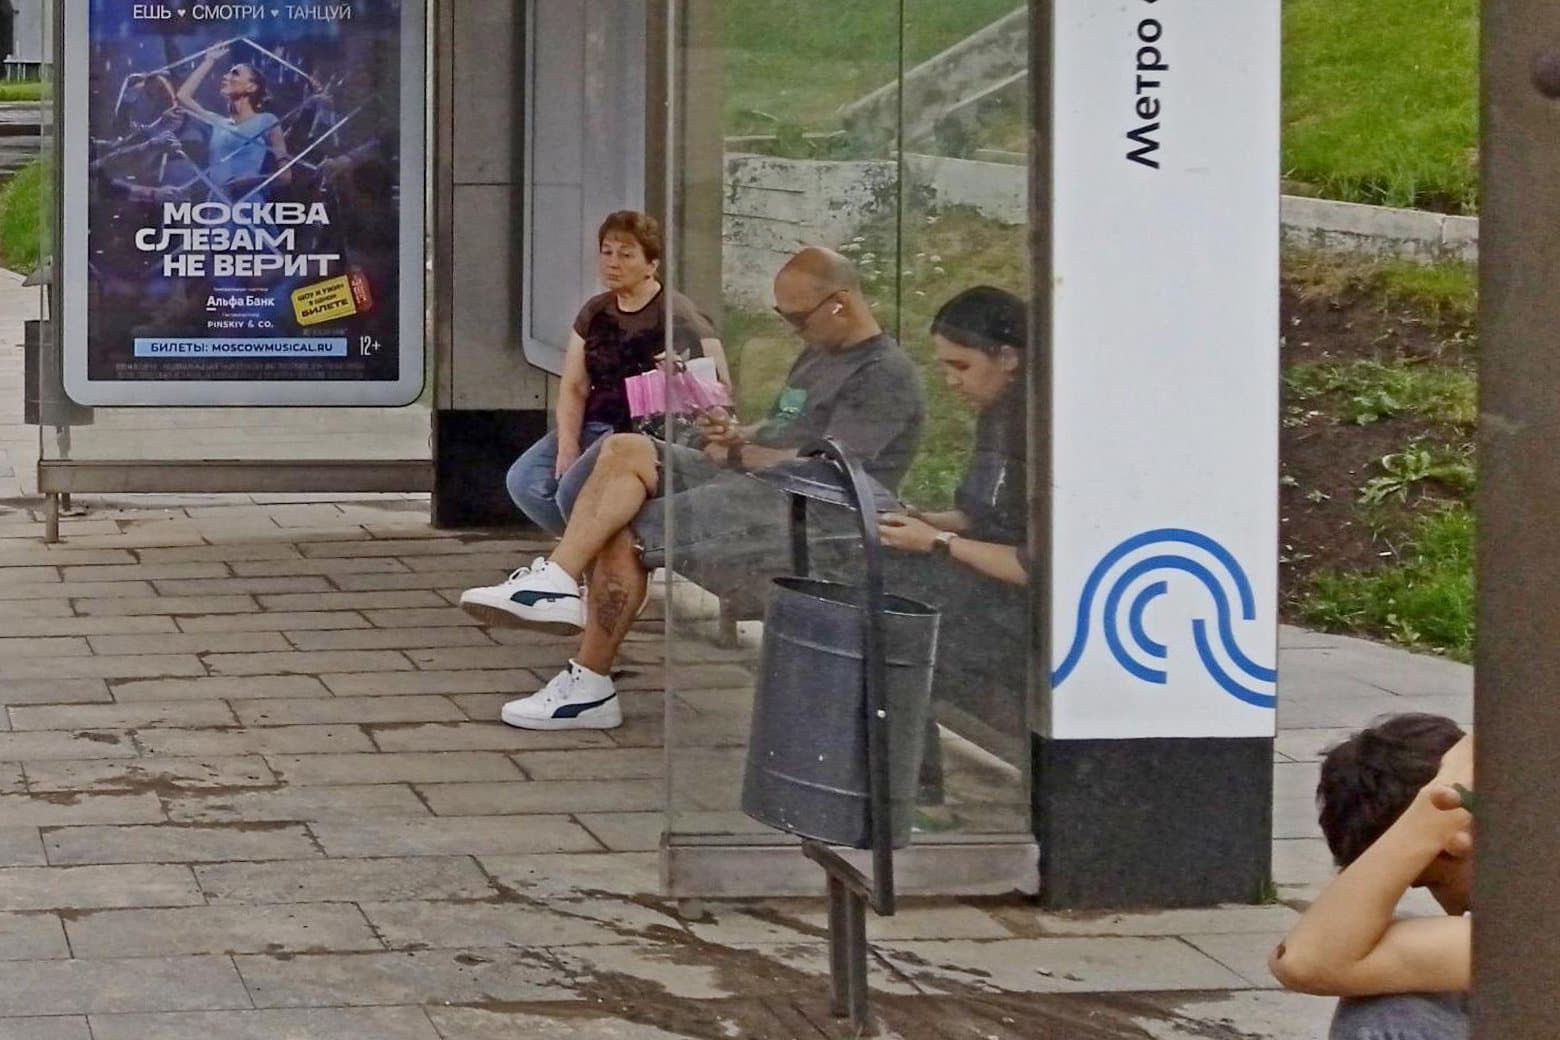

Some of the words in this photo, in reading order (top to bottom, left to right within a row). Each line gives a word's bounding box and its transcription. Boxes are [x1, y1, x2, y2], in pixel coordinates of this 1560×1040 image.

[133, 5, 172, 19] ЕШЬ
[192, 5, 265, 20] СМОТРИ
[286, 3, 352, 22] ТАНЦУЙ
[1126, 18, 1169, 169] Метро
[163, 202, 330, 225] МОСКВА
[135, 228, 295, 251] СЛЕЗАМ
[163, 254, 206, 277] НЕ
[214, 254, 340, 277] ВЕРИТ
[206, 295, 244, 310] Альфа
[246, 295, 275, 306] Банк
[301, 299, 349, 317] БИЛЕТЕ
[150, 342, 209, 353] БИЛЕТЫ:
[211, 343, 333, 353] MOSCOWMUSICAL.RU
[359, 335, 382, 356] 12+
